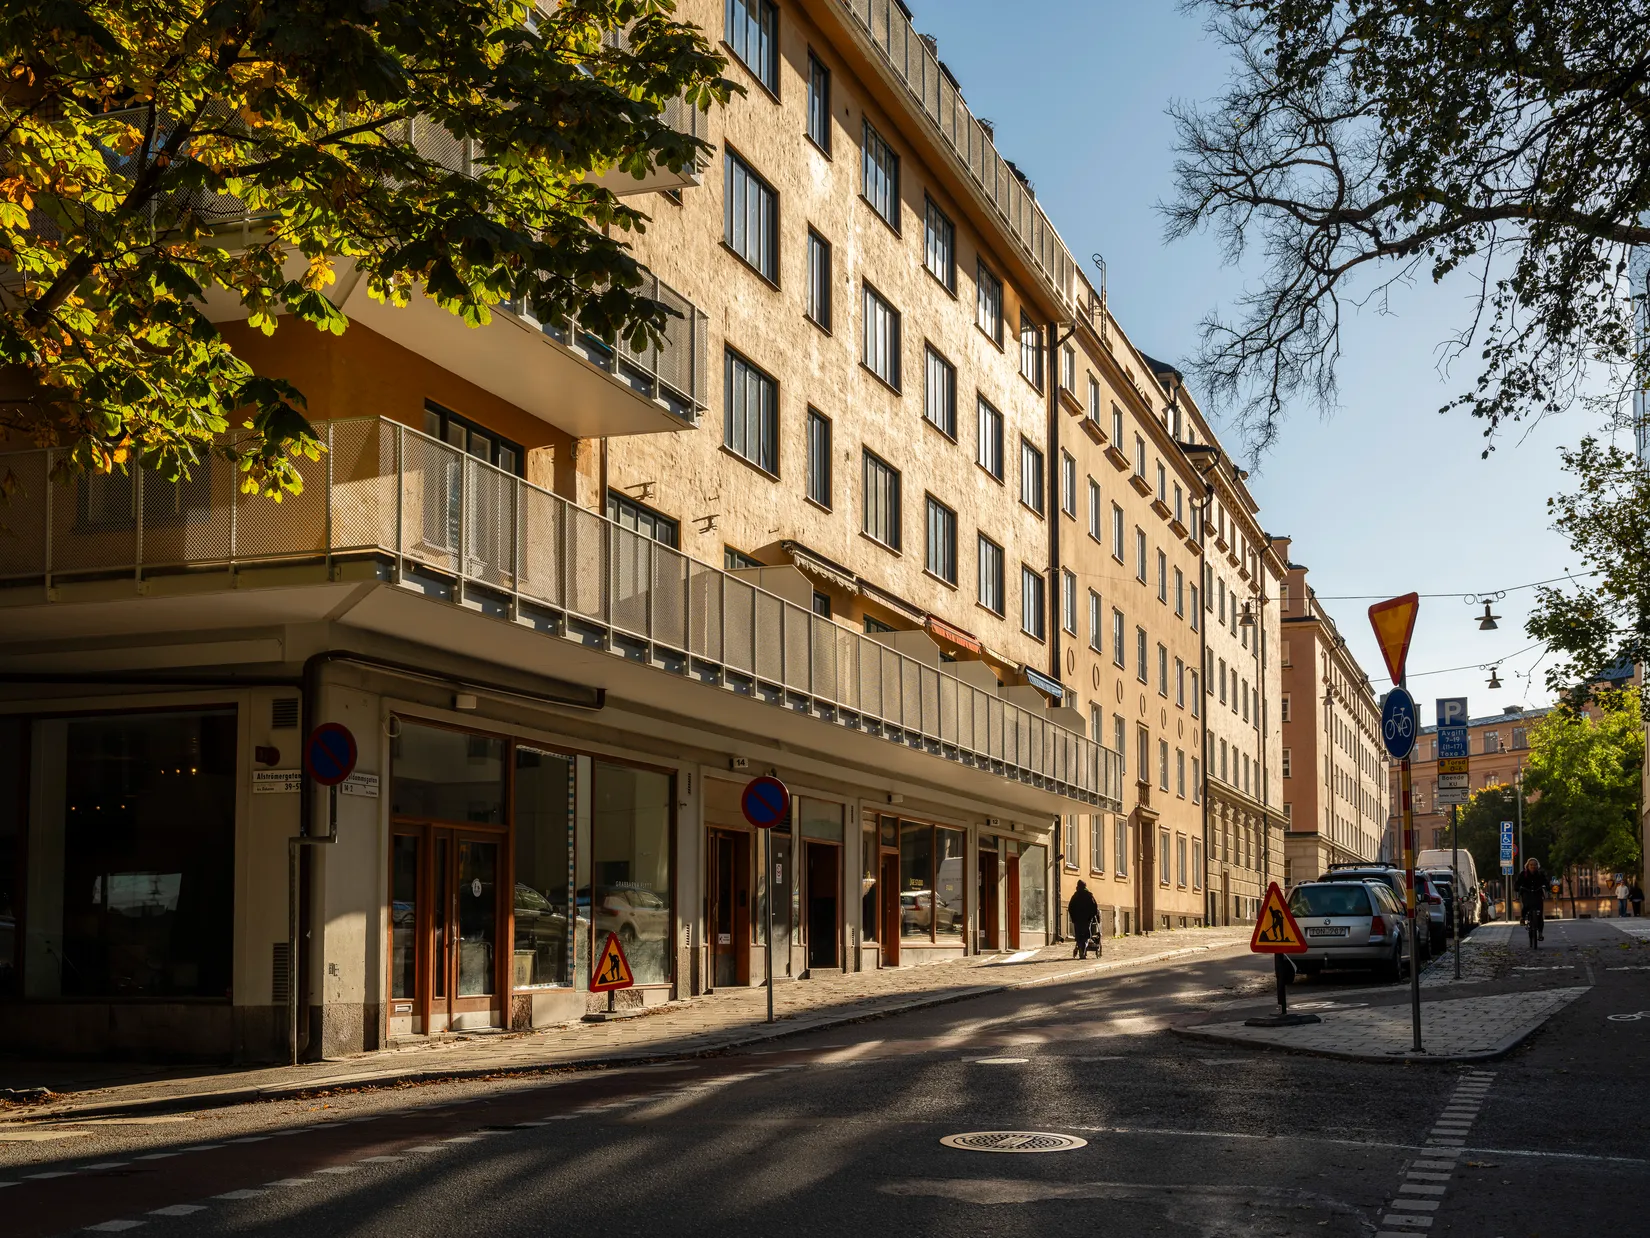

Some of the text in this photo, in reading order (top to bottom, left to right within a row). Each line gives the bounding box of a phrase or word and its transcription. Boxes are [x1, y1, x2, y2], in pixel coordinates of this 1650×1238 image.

[1445, 701, 1461, 725] P
[257, 773, 301, 781] Alströmergatan
[1503, 823, 1511, 832] P
